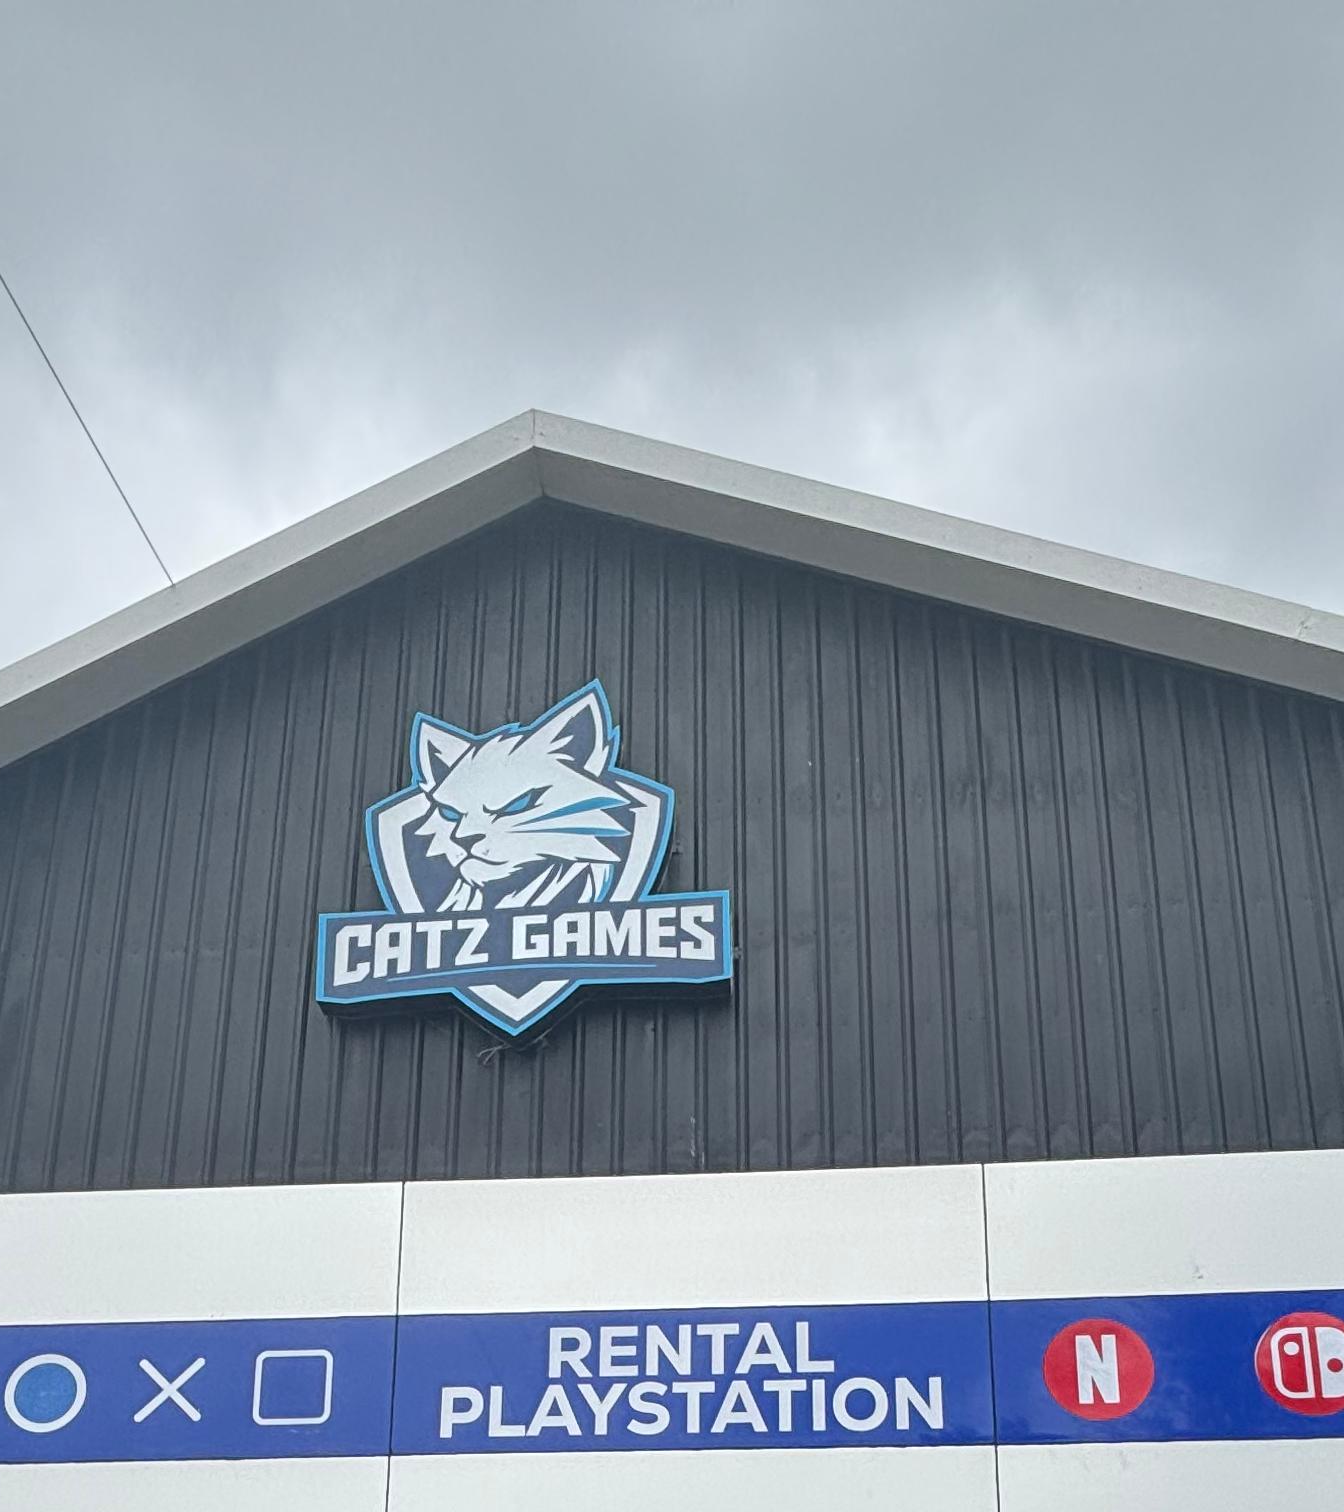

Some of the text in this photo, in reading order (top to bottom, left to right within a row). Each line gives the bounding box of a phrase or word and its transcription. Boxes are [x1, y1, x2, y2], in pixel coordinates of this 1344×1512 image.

[333, 904, 716, 987] CATZ GAMES
[548, 1321, 835, 1378] RENTAL
[1075, 1334, 1121, 1405] N
[439, 1376, 944, 1438] PLAYSTATION
